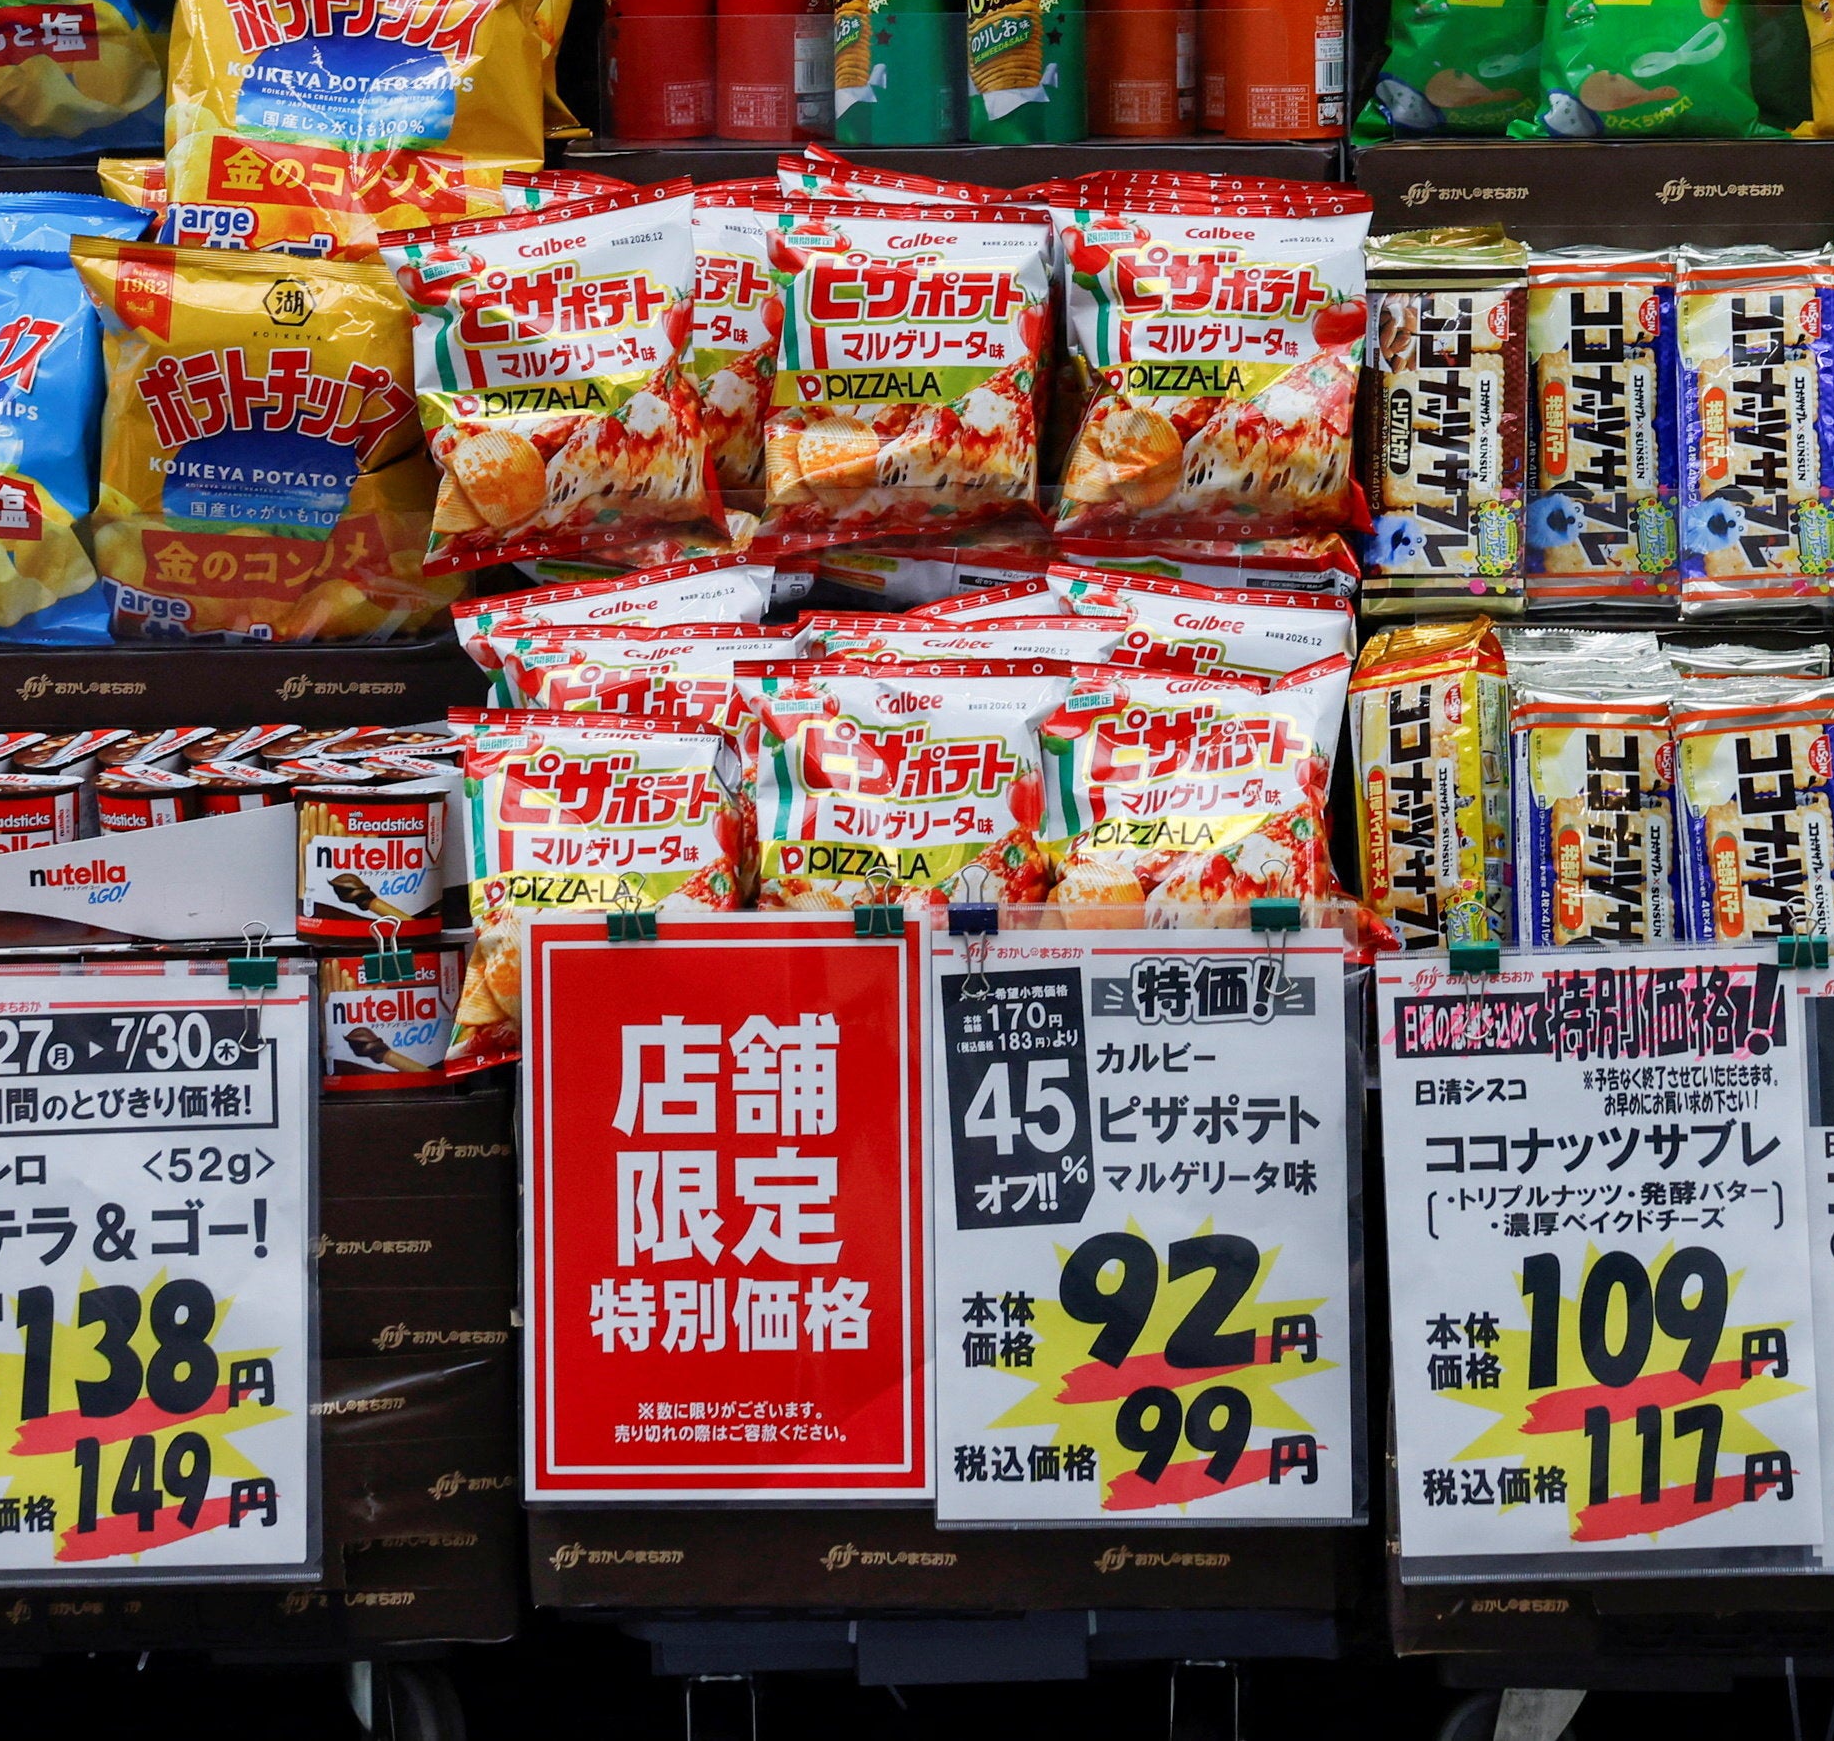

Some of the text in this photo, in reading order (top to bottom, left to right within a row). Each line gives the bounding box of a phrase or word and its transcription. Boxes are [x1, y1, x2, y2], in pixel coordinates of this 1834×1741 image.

[885, 232, 959, 250] Calbee
[807, 254, 1026, 319] ピザポテト
[840, 329, 1006, 360] マルゲリータ味
[347, 818, 424, 832] Breadsticks
[29, 858, 126, 888] nutella
[1137, 958, 1275, 1019] 特価!
[611, 1013, 840, 1139] 店舗
[1097, 1042, 1215, 1074] カルビー
[964, 1060, 1077, 1156] 45
[1414, 1078, 1527, 1107] 日清シスコ
[1098, 1095, 1319, 1144] ピザポテト
[1425, 1122, 1780, 1175] ココナッツサブレ
[1102, 1163, 1317, 1196] マルゲリータ味
[616, 1149, 844, 1268] 限定
[589, 1277, 871, 1353] 特別価格
[614, 1423, 849, 1445] 売り切れの際はご容赦ください。
